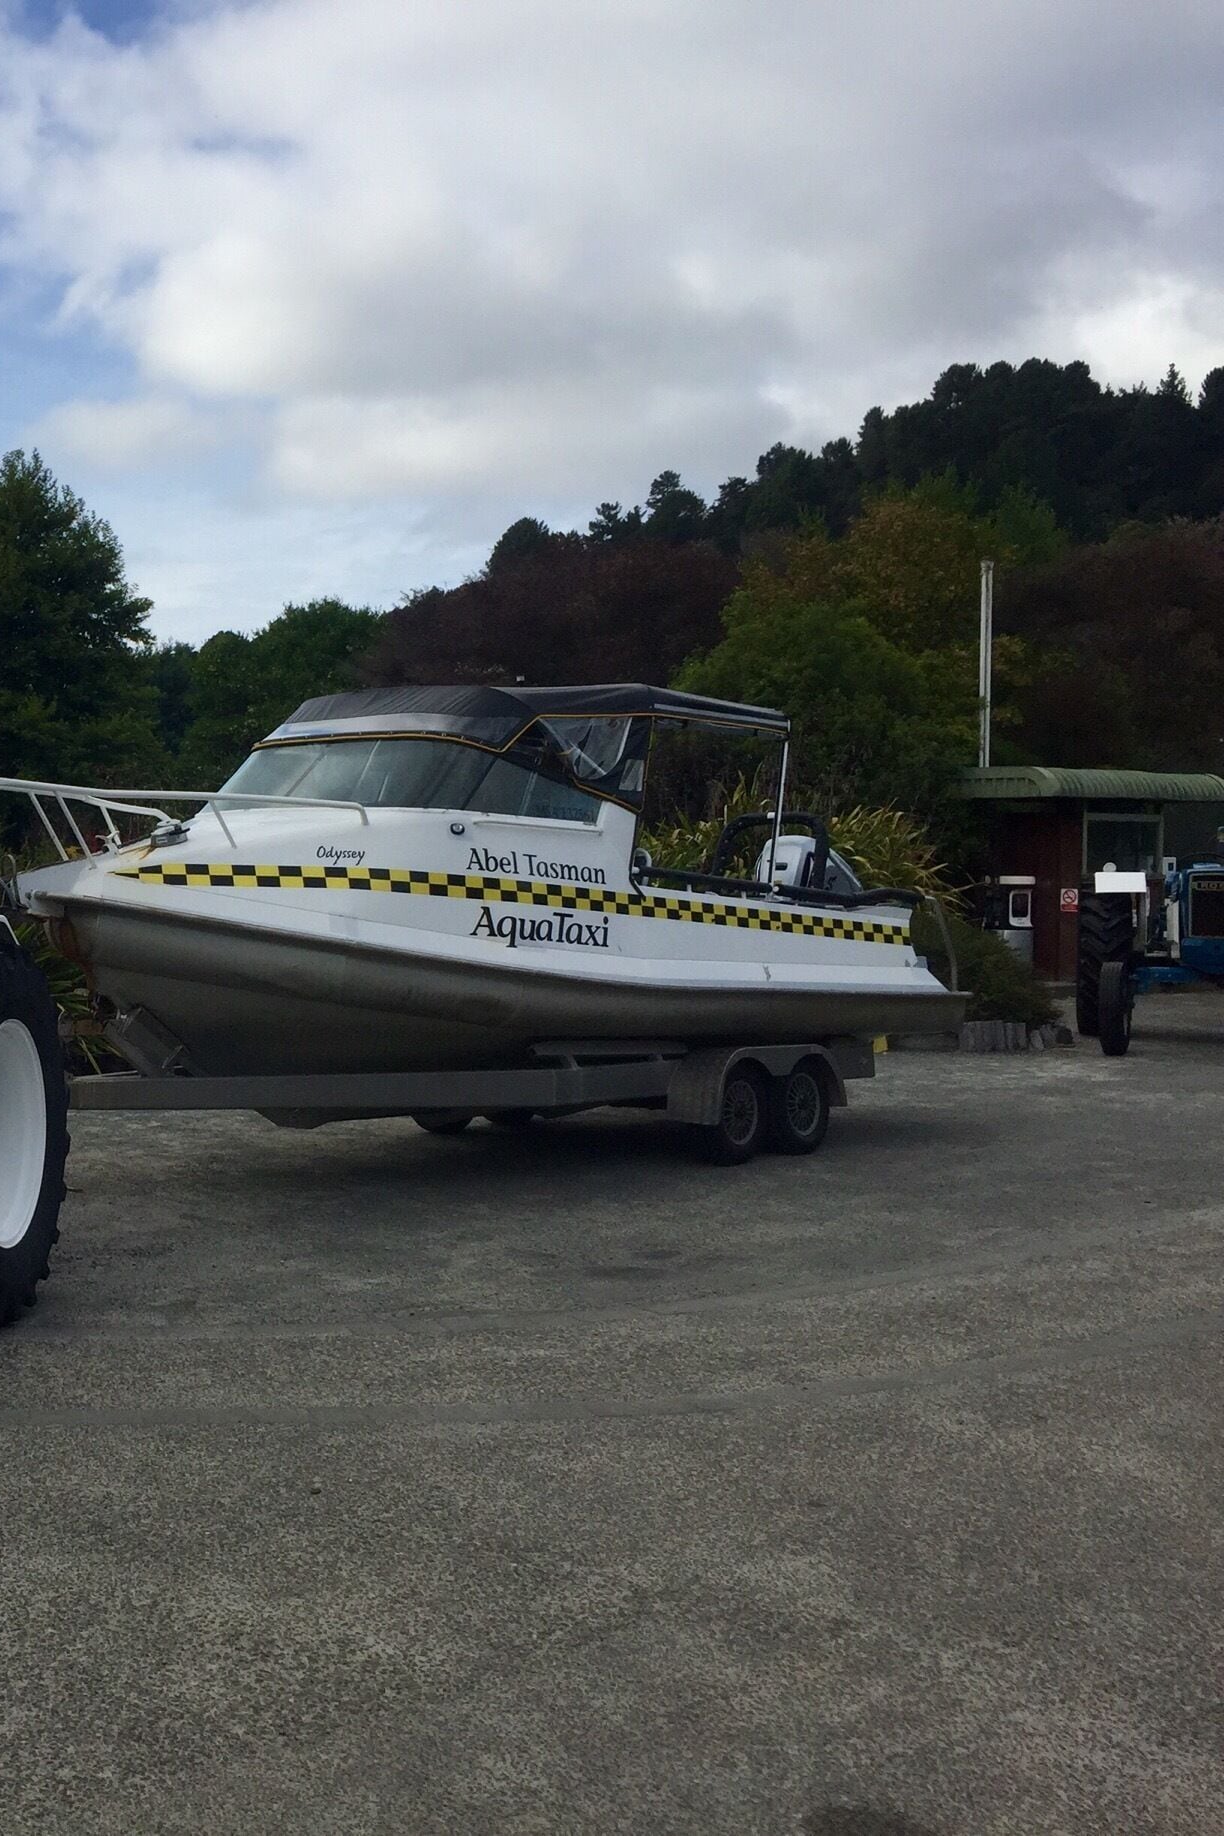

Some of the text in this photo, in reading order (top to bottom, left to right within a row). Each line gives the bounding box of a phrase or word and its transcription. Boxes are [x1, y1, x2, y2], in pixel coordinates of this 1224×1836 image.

[316, 846, 366, 865] Odyssey
[466, 847, 606, 885] Abel Tasman
[470, 906, 609, 948] AquaTaxi
